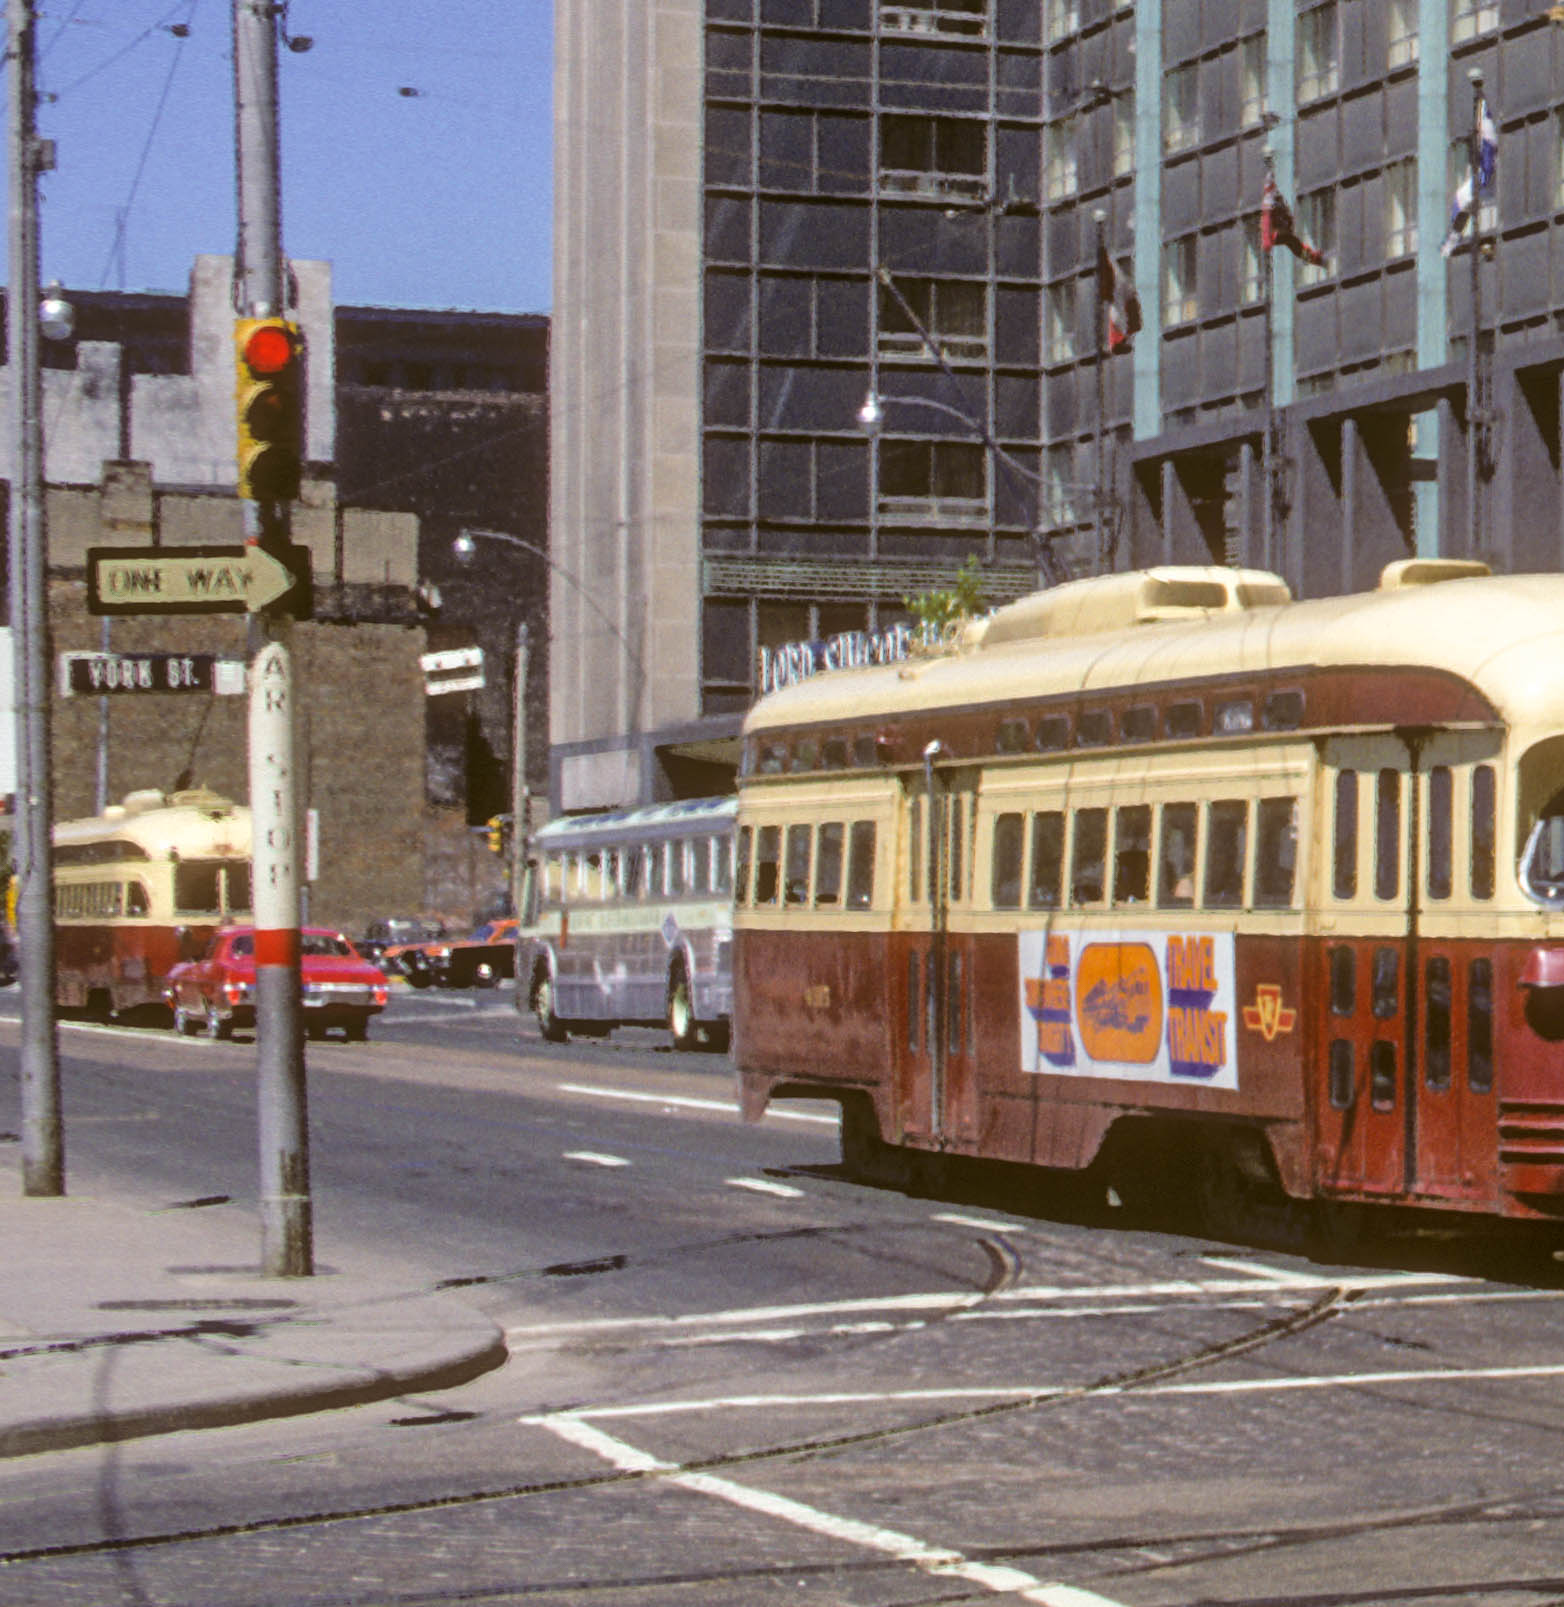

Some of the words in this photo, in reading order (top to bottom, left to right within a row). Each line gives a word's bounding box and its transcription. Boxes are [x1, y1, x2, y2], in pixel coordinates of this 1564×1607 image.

[107, 566, 161, 596] ONE
[187, 566, 254, 595] WAY
[87, 659, 153, 689] YORK
[166, 657, 200, 689] ST.
[1167, 935, 1217, 994] TRAVEL
[1167, 1009, 1227, 1066] TRANSIT
